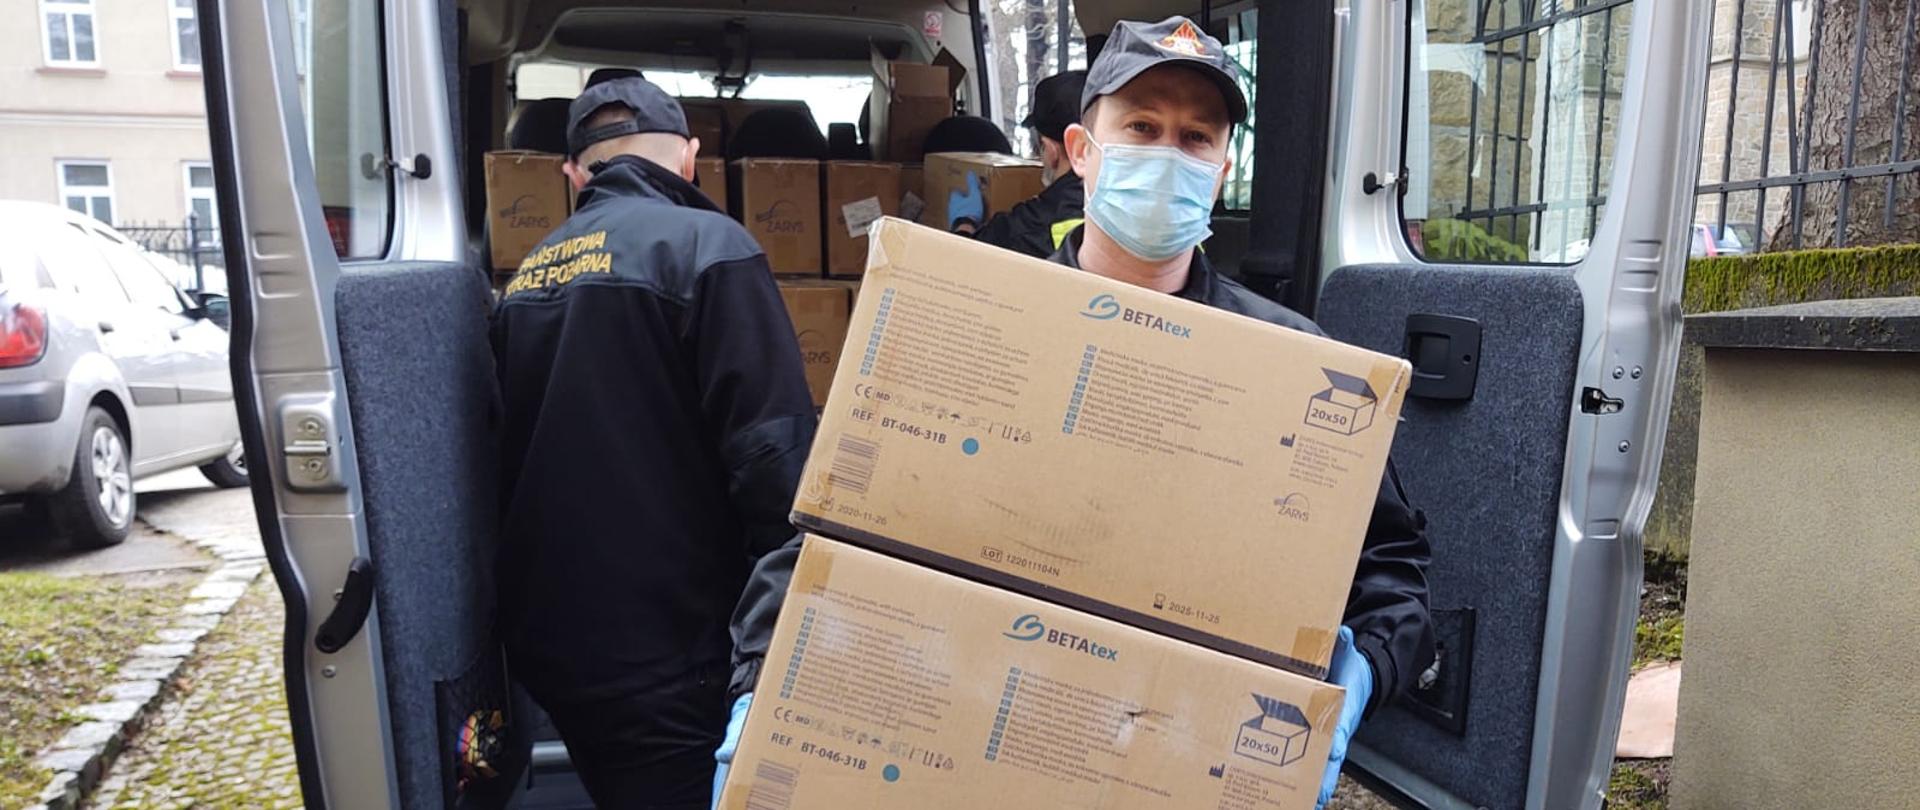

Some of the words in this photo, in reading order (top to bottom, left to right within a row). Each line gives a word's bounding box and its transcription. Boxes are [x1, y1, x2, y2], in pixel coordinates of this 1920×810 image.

[1122, 307, 1192, 339] BETAtex
[852, 408, 874, 422] REF
[881, 416, 947, 444] BT-046-31B
[1311, 407, 1347, 426] 20x50
[1278, 504, 1310, 522] ZARYS
[983, 548, 1001, 561] LOT
[1047, 628, 1119, 661] BETAtex
[770, 732, 794, 747] REF
[801, 741, 868, 770] BT-046-31B
[1240, 736, 1279, 756] 20x50
